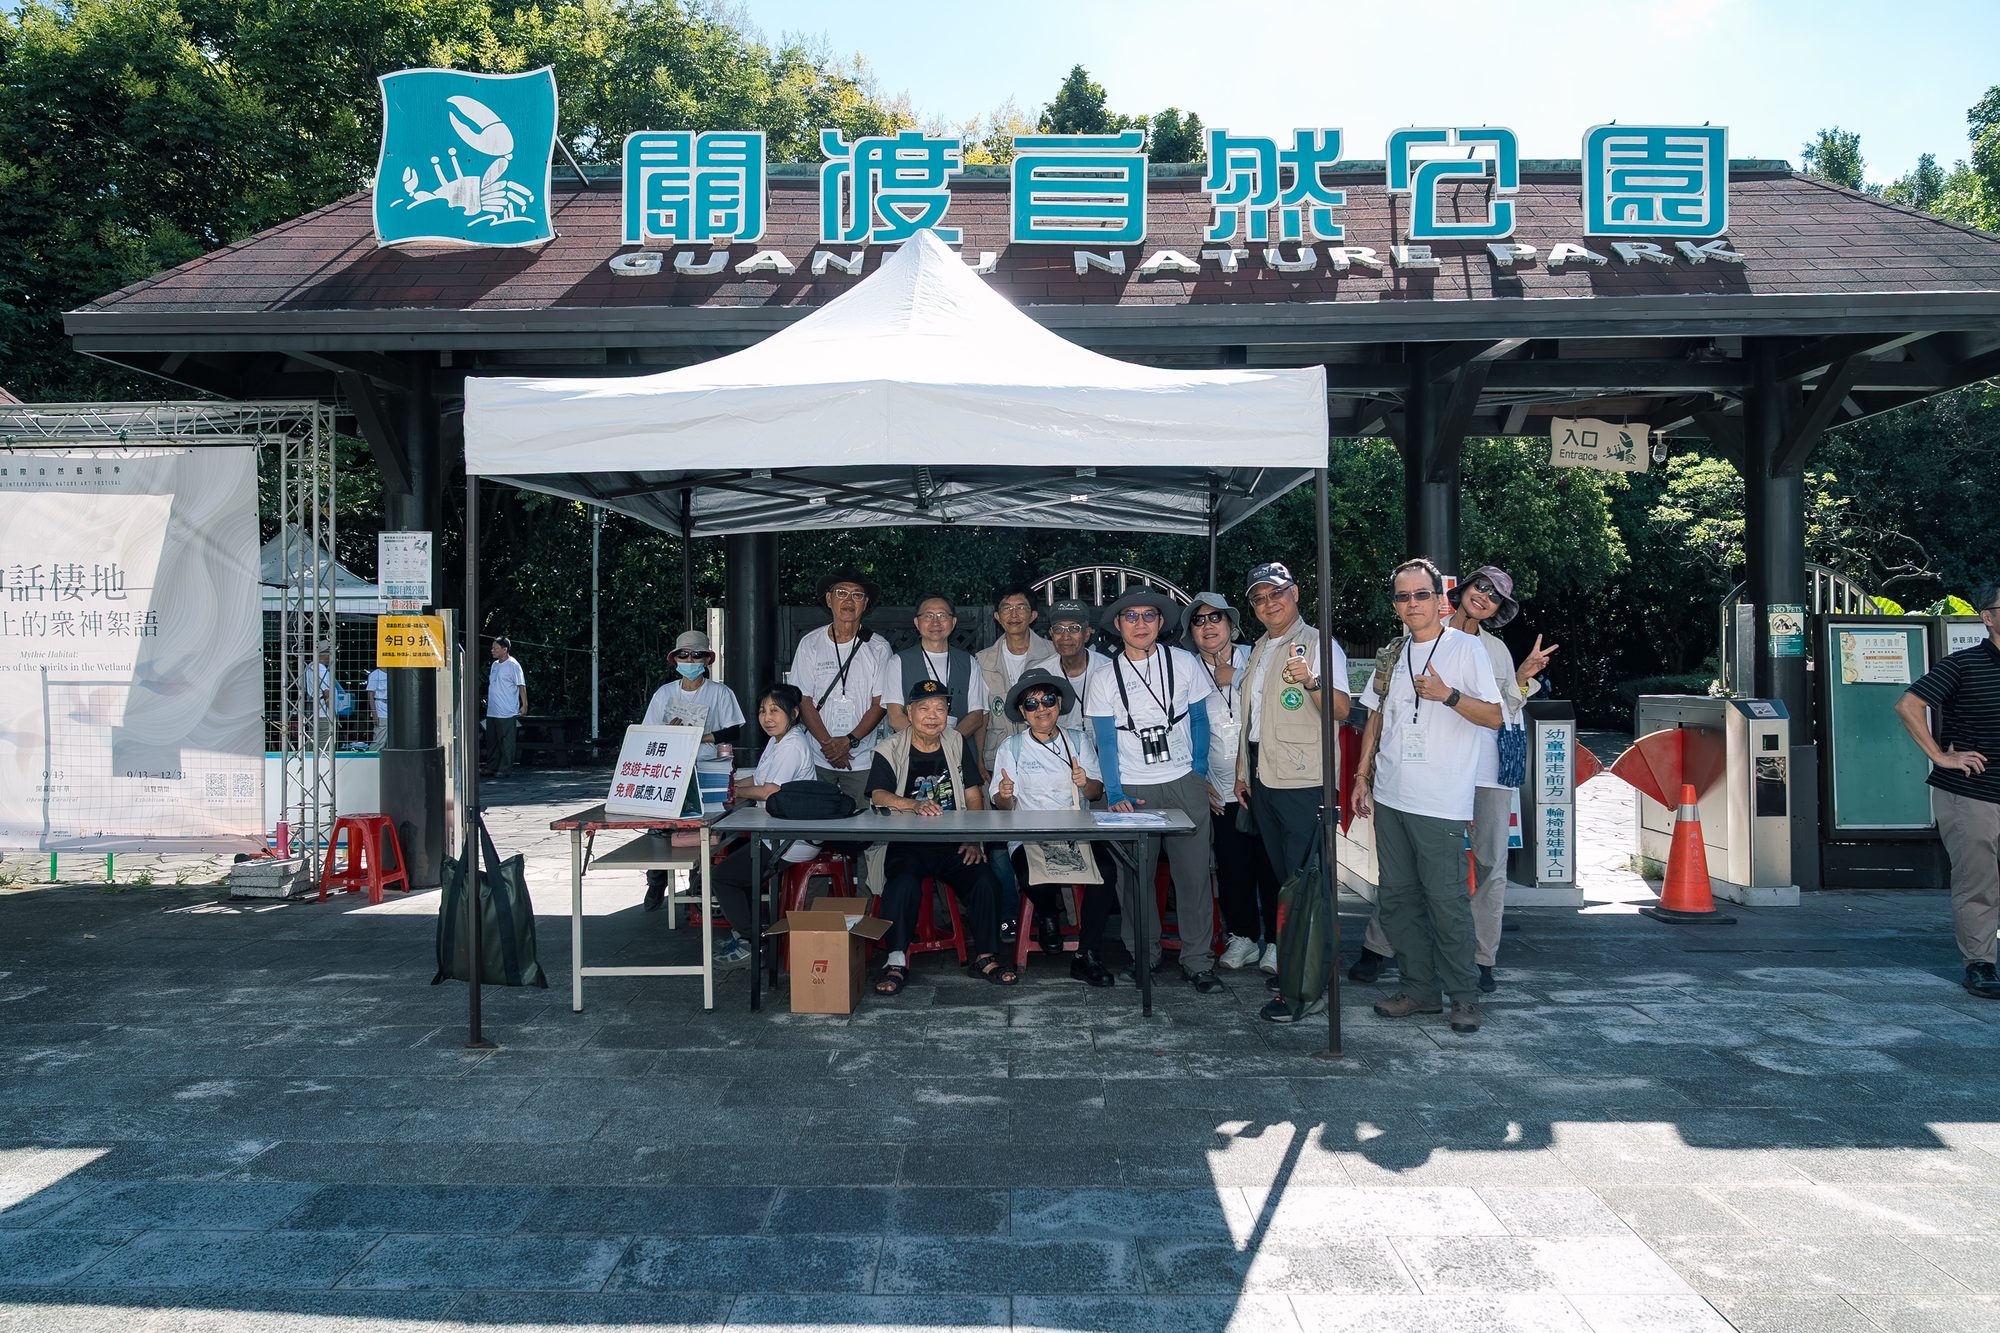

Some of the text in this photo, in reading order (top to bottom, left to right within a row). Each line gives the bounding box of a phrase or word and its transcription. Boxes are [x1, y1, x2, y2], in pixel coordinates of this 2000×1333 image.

[609, 238, 1745, 277] GUANU NATURE PARK
[1562, 428, 1599, 448] 入口
[1560, 448, 1598, 461] Entrance
[384, 635, 404, 647] 今日
[406, 635, 416, 646] 9
[19, 651, 46, 660] Mythic
[12, 663, 22, 671] of
[23, 663, 38, 672] the
[40, 663, 69, 673] Spirits
[70, 663, 80, 671] in
[81, 663, 95, 671] the
[97, 663, 132, 672] Wetland
[645, 741, 668, 757] 請用
[620, 761, 682, 780] 悠遊卡或IC卡
[1544, 728, 1566, 797] 幼童請走前方
[614, 782, 676, 803] 免費感應入園
[1546, 807, 1565, 878] 輪椅娃娃車入口
